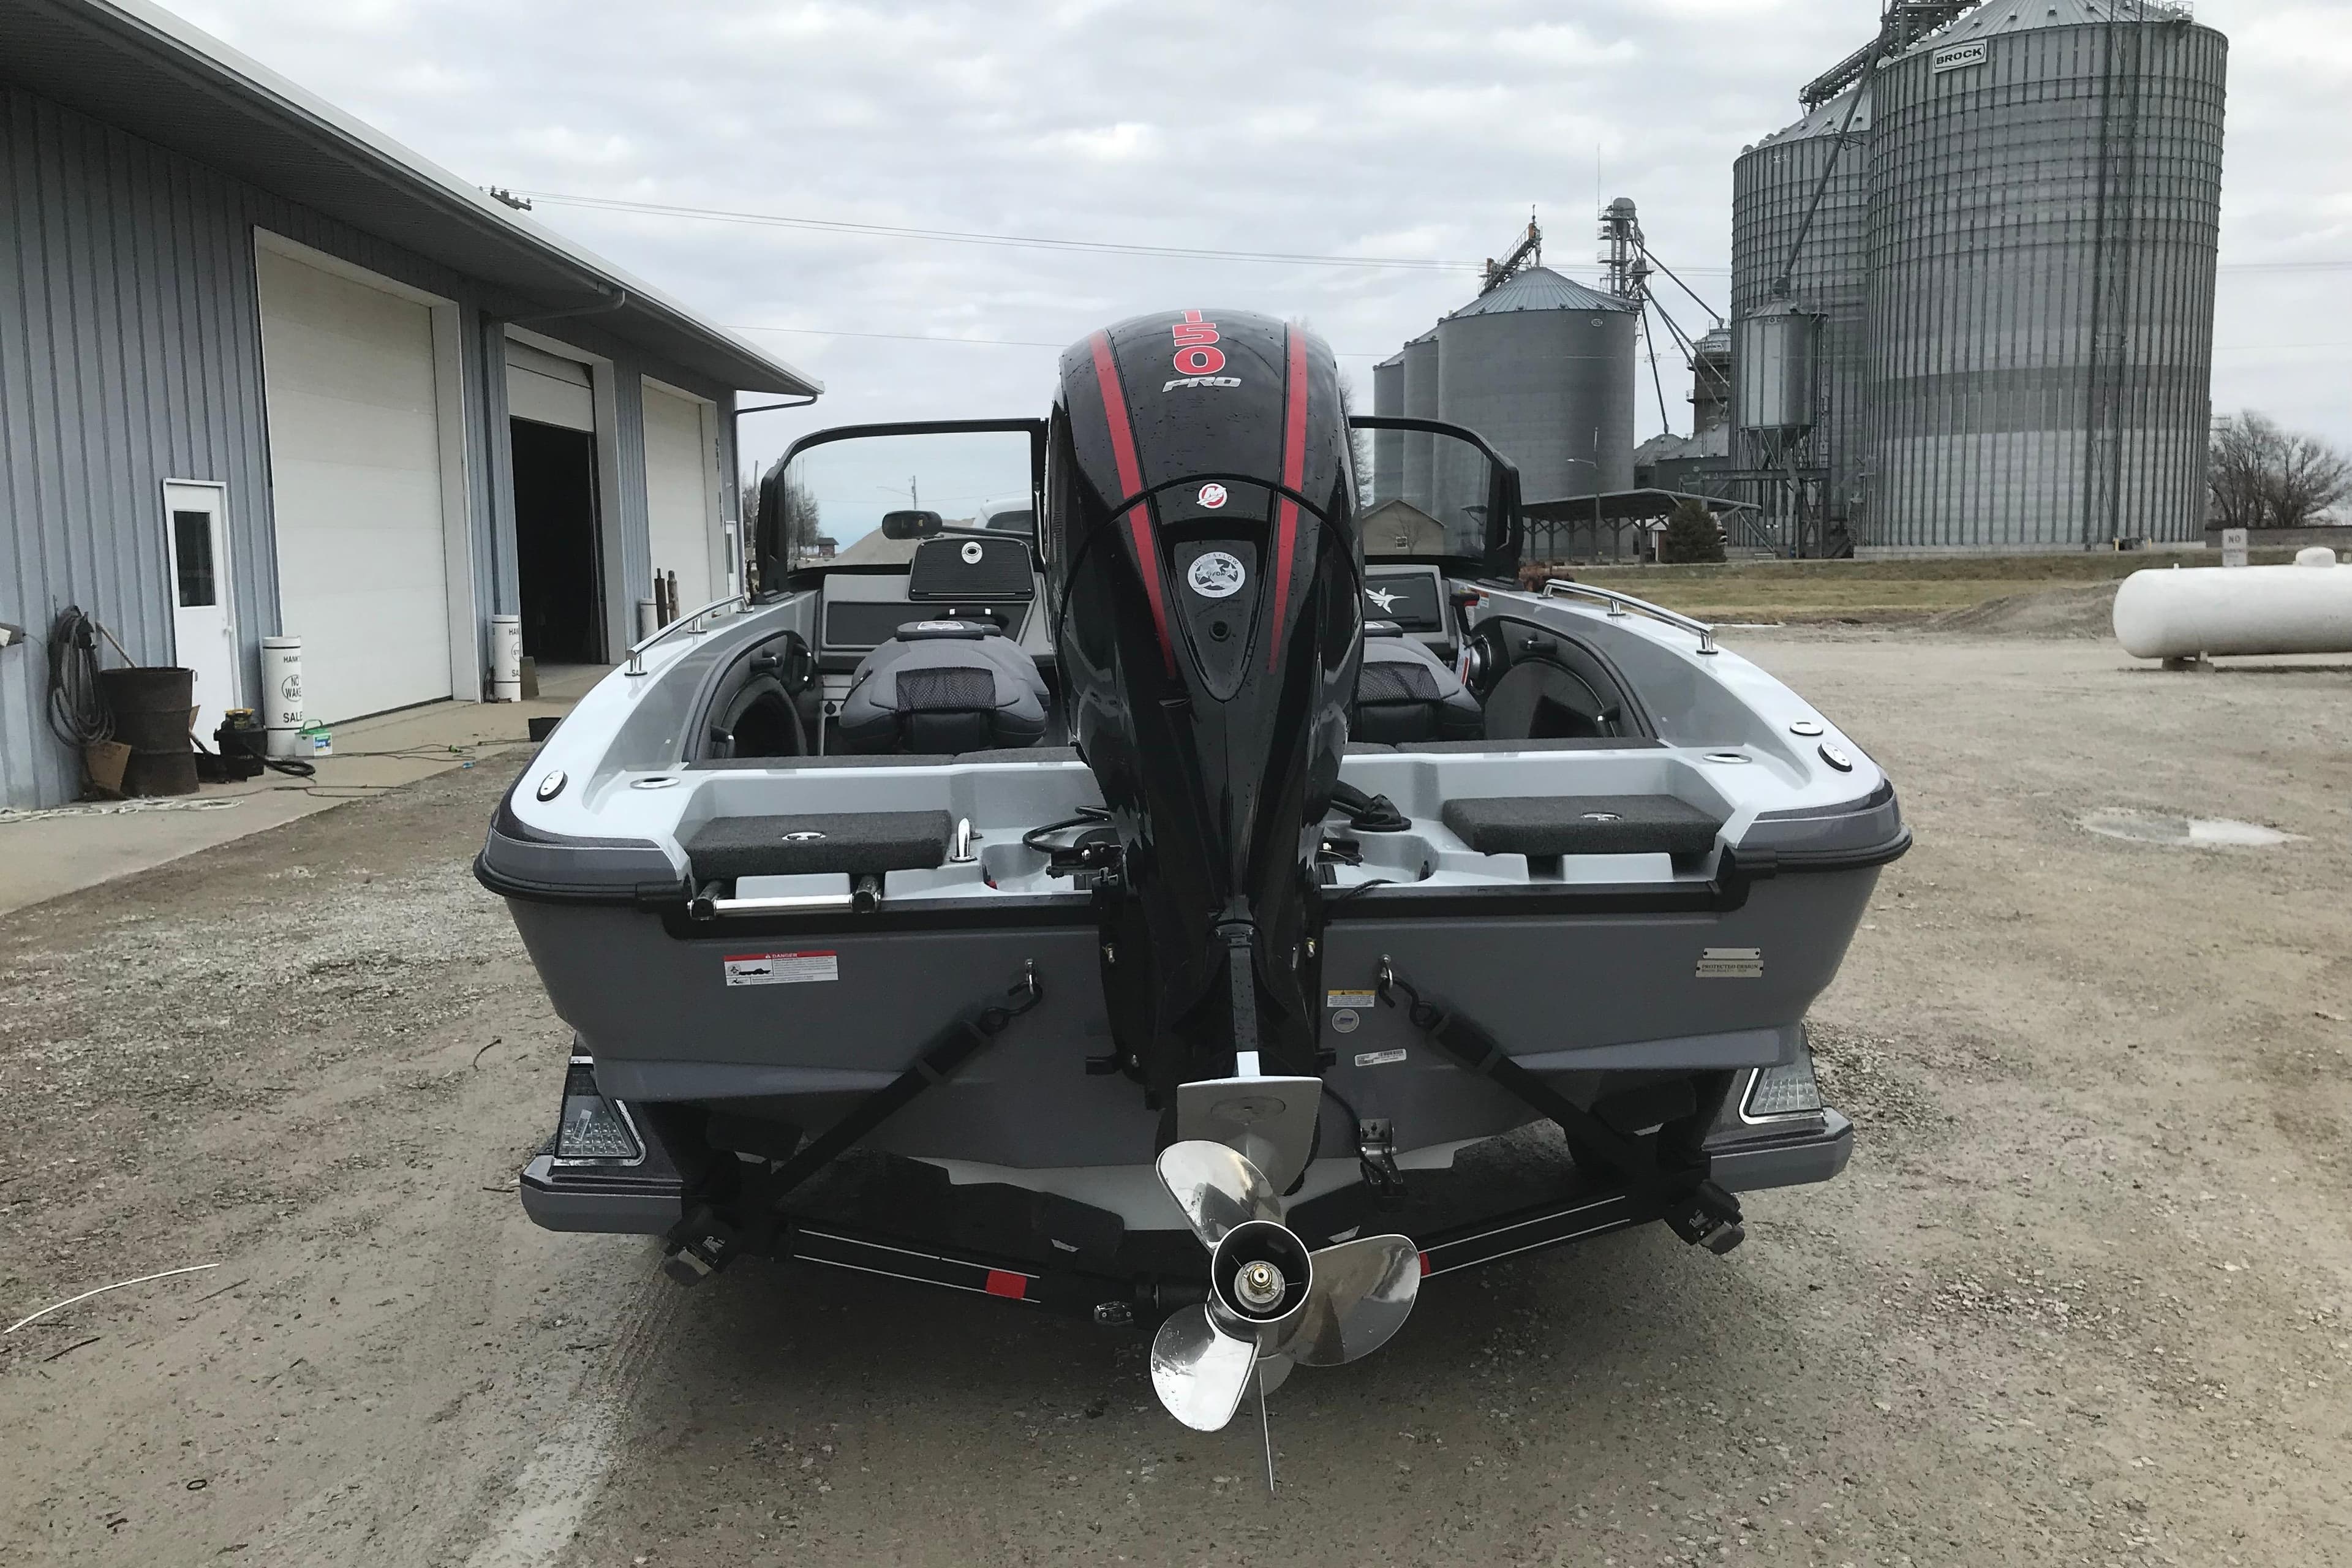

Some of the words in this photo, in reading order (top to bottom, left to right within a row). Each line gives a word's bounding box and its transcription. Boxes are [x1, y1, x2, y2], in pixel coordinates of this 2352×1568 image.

[1936, 48, 1982, 64] BROCK
[1172, 309, 1226, 375] 150
[1163, 377, 1242, 393] PRO
[2228, 535, 2241, 544] NO
[1223, 555, 1239, 565] LOW
[291, 676, 300, 686] NO
[285, 687, 301, 698] WAKE
